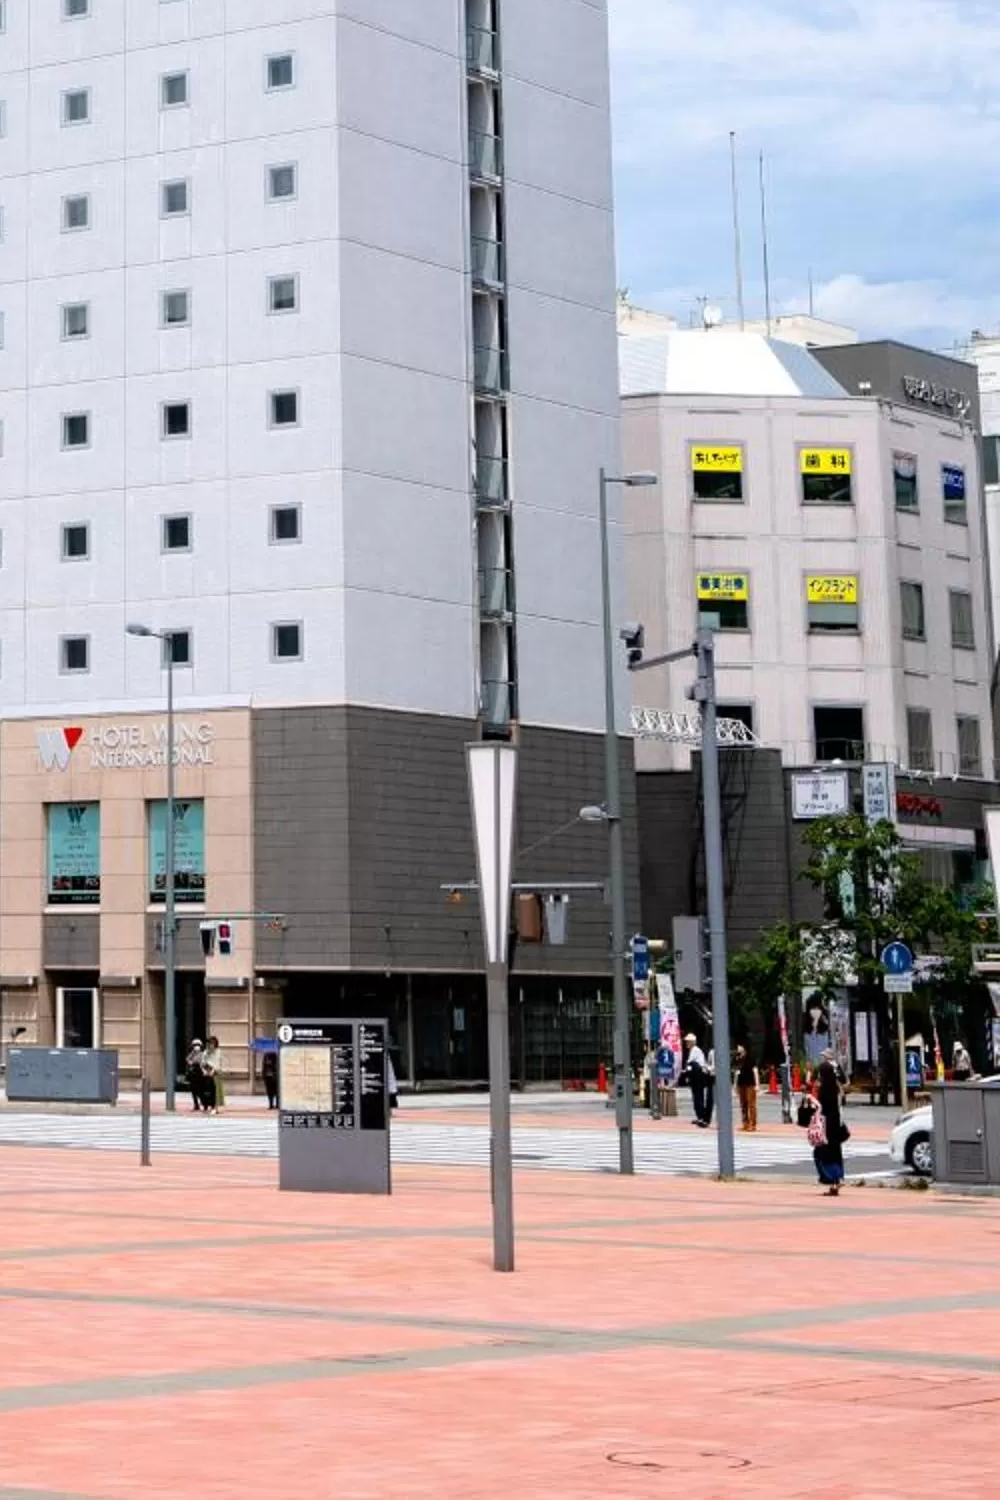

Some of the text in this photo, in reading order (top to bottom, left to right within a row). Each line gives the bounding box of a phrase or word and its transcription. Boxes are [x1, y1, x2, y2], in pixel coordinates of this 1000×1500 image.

[90, 725, 147, 750] HOTEL
[152, 719, 215, 746] WING
[91, 744, 214, 769] INTERNATIONAL
